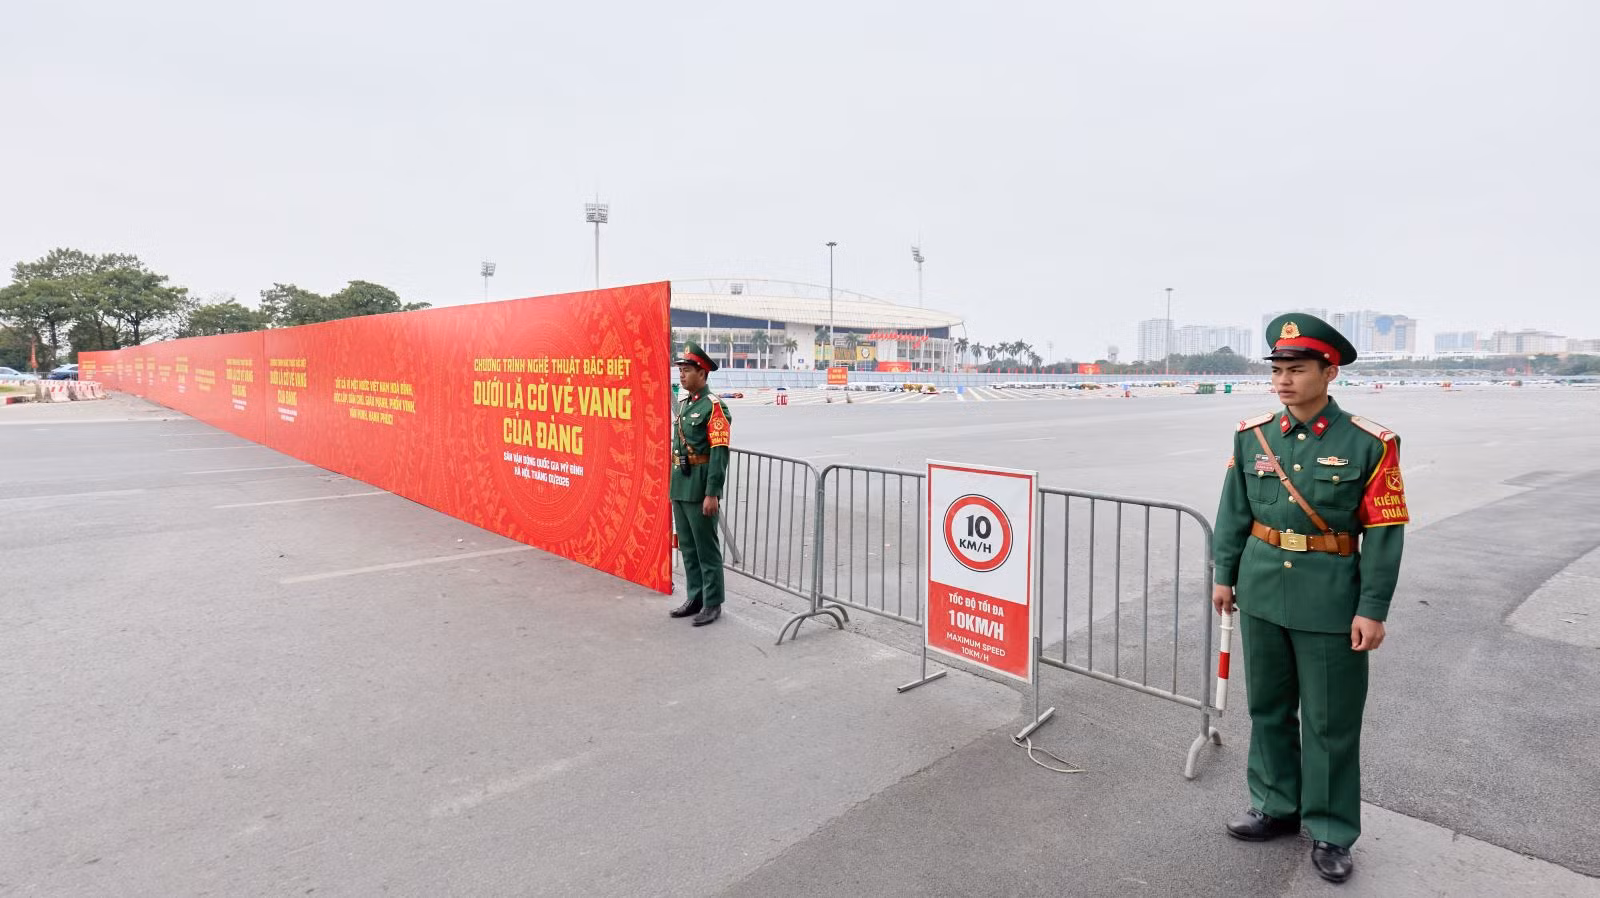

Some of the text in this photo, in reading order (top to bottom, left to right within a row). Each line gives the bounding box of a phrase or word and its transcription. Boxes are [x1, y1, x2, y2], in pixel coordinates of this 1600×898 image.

[503, 356, 525, 373] TRÌNH
[527, 356, 549, 377] NGHỆ
[552, 356, 580, 378] THUẬT
[583, 356, 604, 379] ĐẶC
[607, 356, 632, 380] BIỆT
[473, 376, 504, 407] DƯỚI
[527, 377, 549, 412] CỜ
[552, 377, 574, 414] VẺ
[577, 386, 632, 420] VANG
[503, 410, 583, 456] CỦA ĐẢNG
[550, 460, 560, 471] GIA
[560, 461, 569, 474] MỸ
[1374, 492, 1401, 506] KIỂM
[966, 515, 992, 539] 10
[959, 538, 992, 554] KM/H
[949, 592, 1004, 617] TỐC ĐỘ TỐI ĐA
[948, 609, 1004, 641] 10KM/H
[946, 631, 1006, 657] MAXIMUM SPEED
[961, 646, 989, 662] 10KM/H
